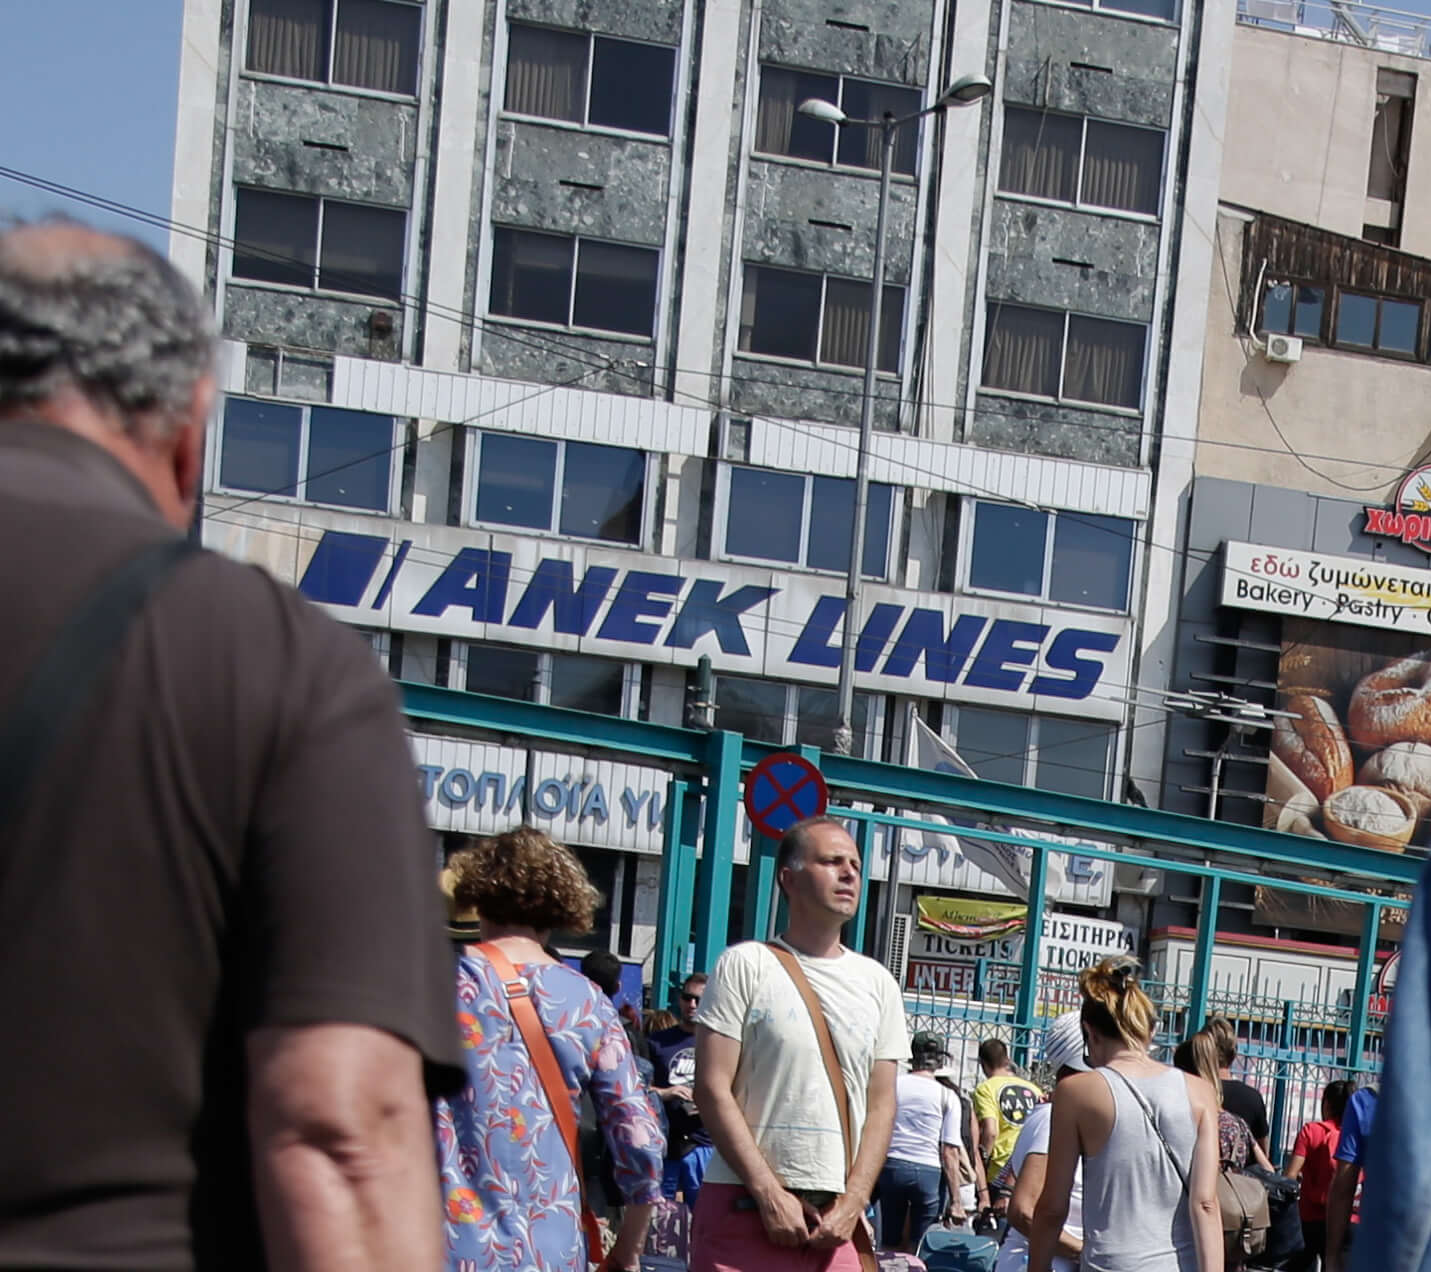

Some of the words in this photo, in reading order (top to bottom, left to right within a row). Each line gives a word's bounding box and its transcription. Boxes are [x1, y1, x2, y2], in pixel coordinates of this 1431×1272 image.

[1250, 554, 1300, 579] εδώ
[1236, 578, 1314, 611] Bakery
[1337, 593, 1404, 624] Pastry
[412, 546, 780, 657] ANEK
[787, 595, 1121, 700] LINES
[914, 963, 1024, 997] INTERET
